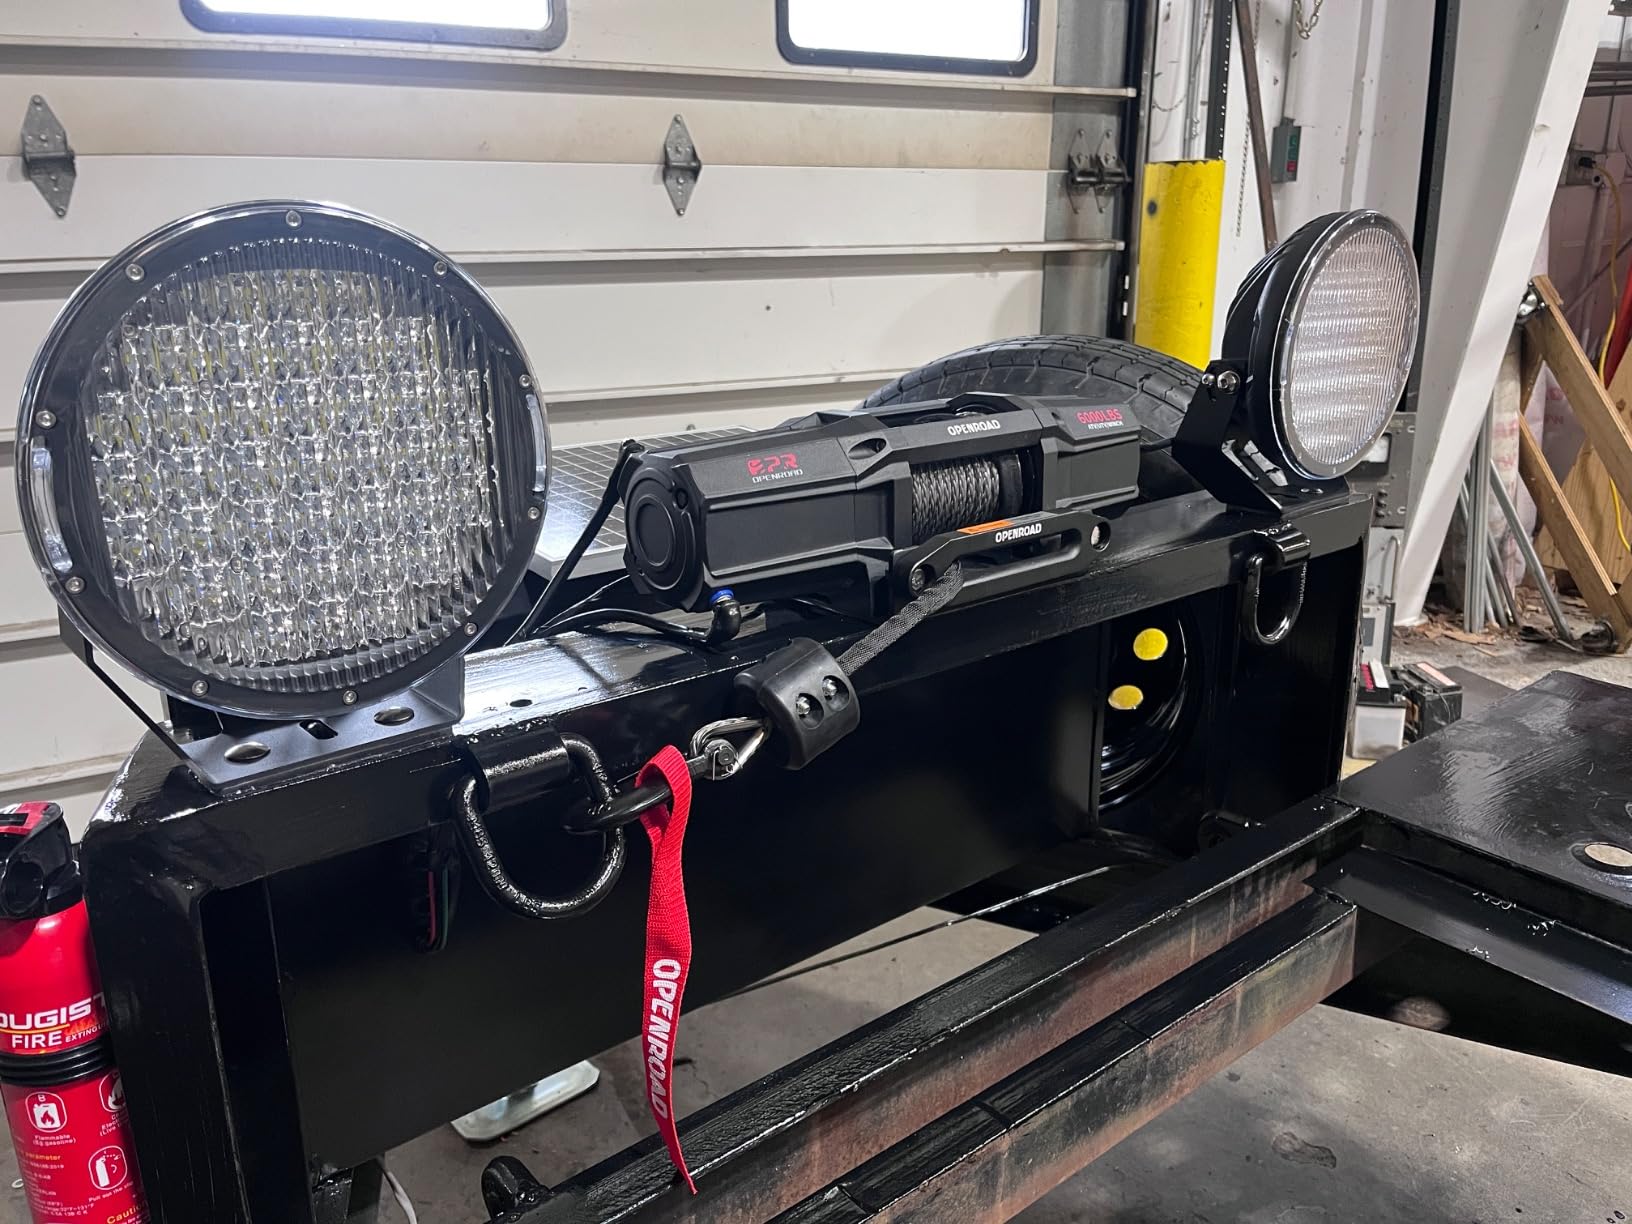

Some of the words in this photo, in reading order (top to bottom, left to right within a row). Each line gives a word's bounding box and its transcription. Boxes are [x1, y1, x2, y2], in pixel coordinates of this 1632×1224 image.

[1076, 408, 1123, 424] 6000LBS
[947, 419, 1001, 436] OPENROAD
[751, 468, 804, 484] OPENROAD
[995, 523, 1042, 543] OPENROAD
[12, 1030, 63, 1049] FIRE
[648, 958, 682, 1120] OPENROAD
[37, 1094, 46, 1103] B
